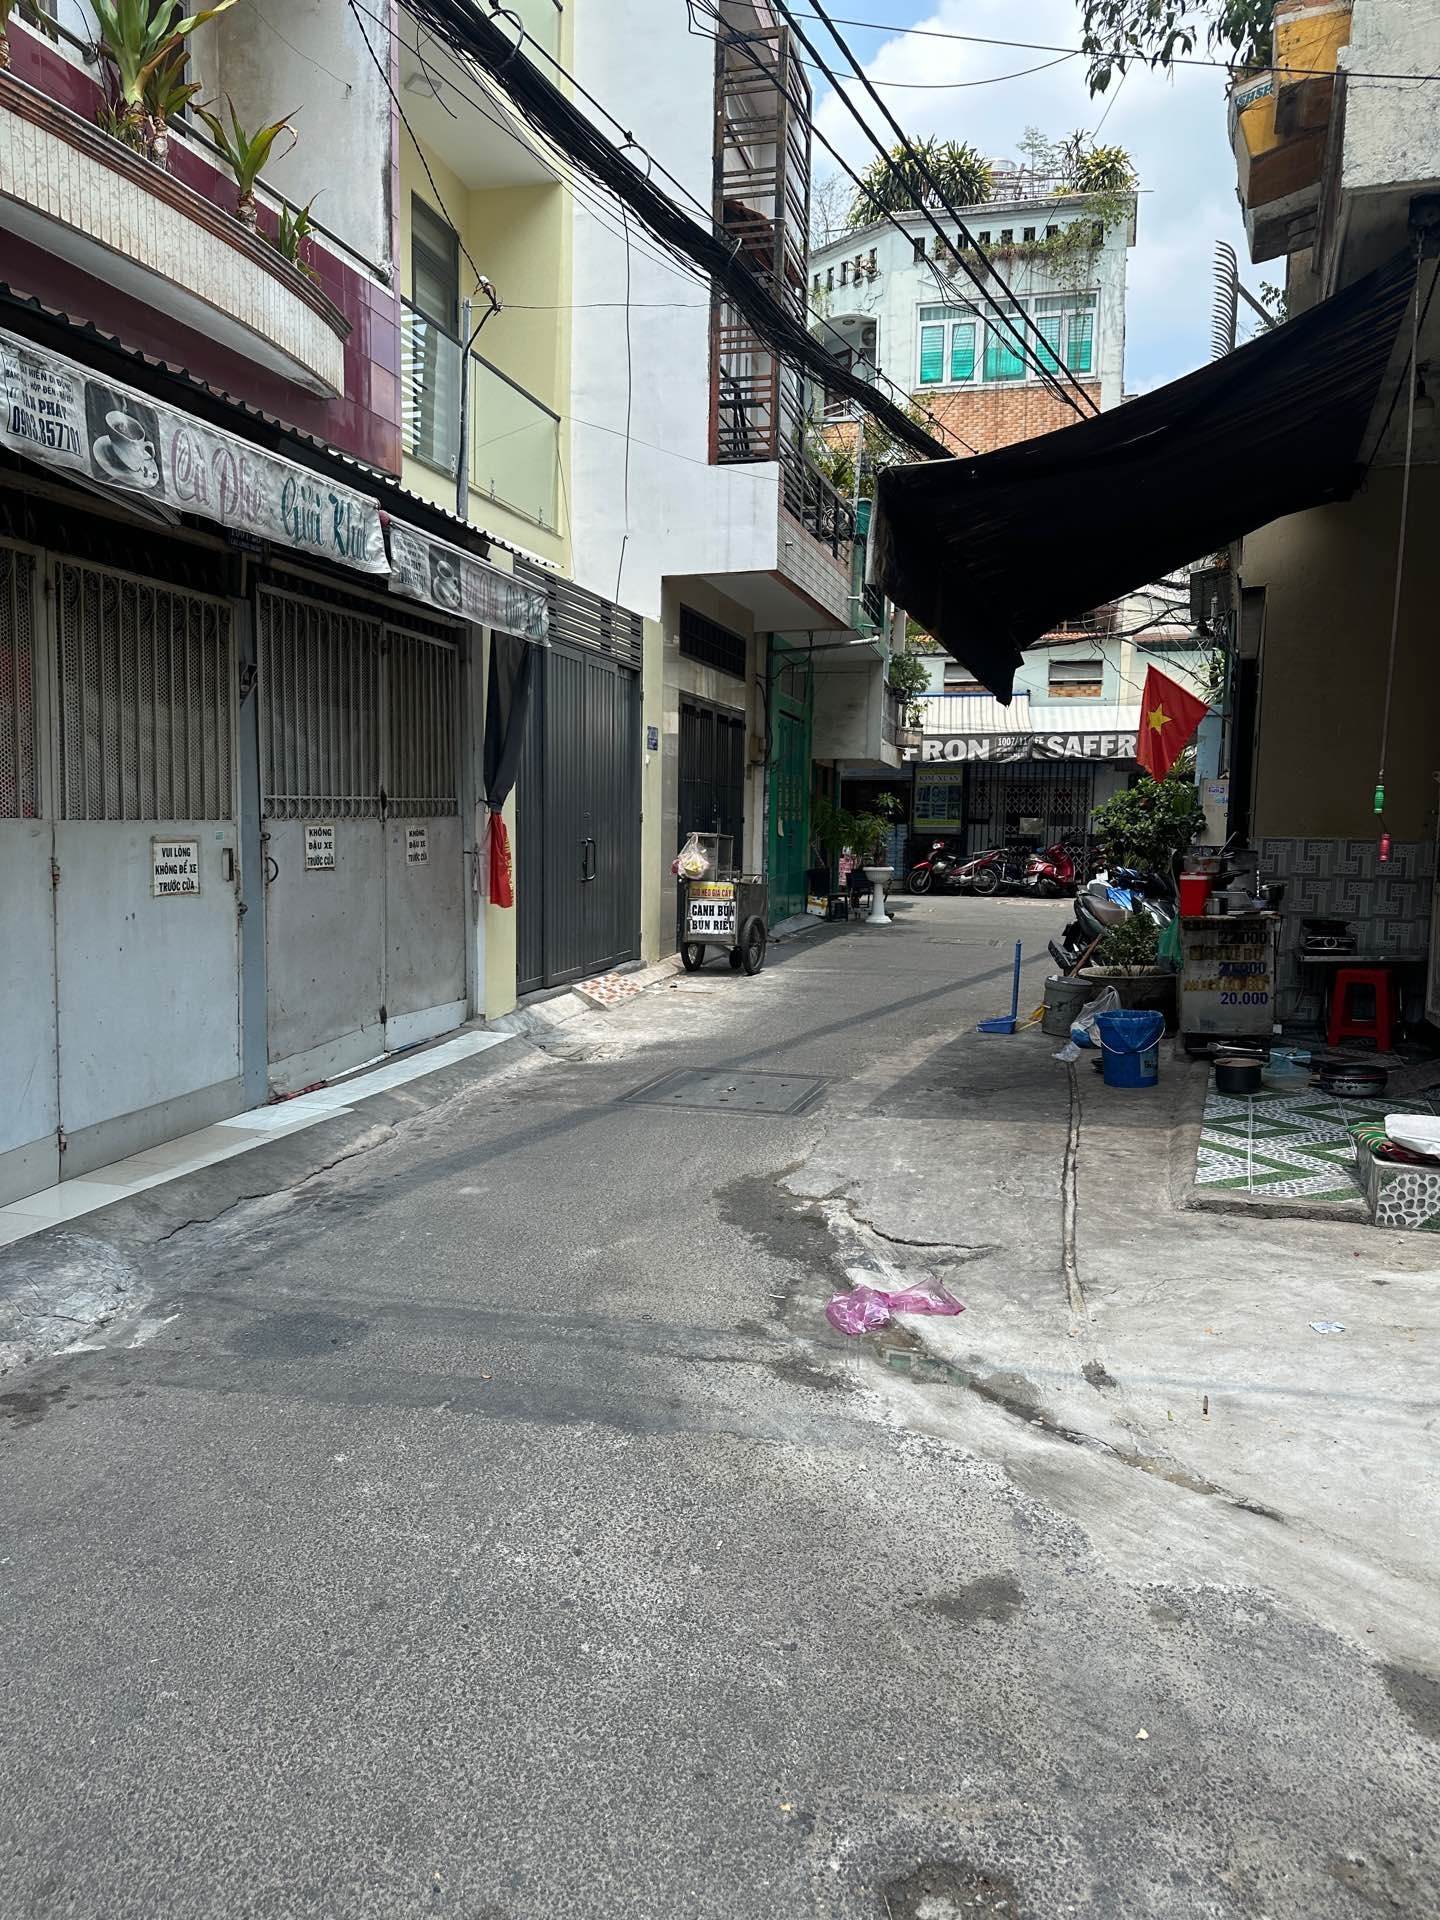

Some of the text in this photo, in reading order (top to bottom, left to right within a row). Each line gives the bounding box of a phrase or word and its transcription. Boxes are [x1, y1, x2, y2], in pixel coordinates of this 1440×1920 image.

[1047, 734, 1137, 759] SAFFR
[309, 827, 332, 837] KHÔNG
[161, 845, 191, 857] VUI LÒNG
[308, 840, 322, 851] ĐẬU
[155, 859, 197, 875] KHÔNG ĐỂ XE
[158, 877, 195, 892] TRƯỚC CỬA
[692, 902, 735, 916] CANH BÚN
[692, 917, 735, 930] BÚN RIÊU
[1220, 992, 1268, 1004] 20.000
